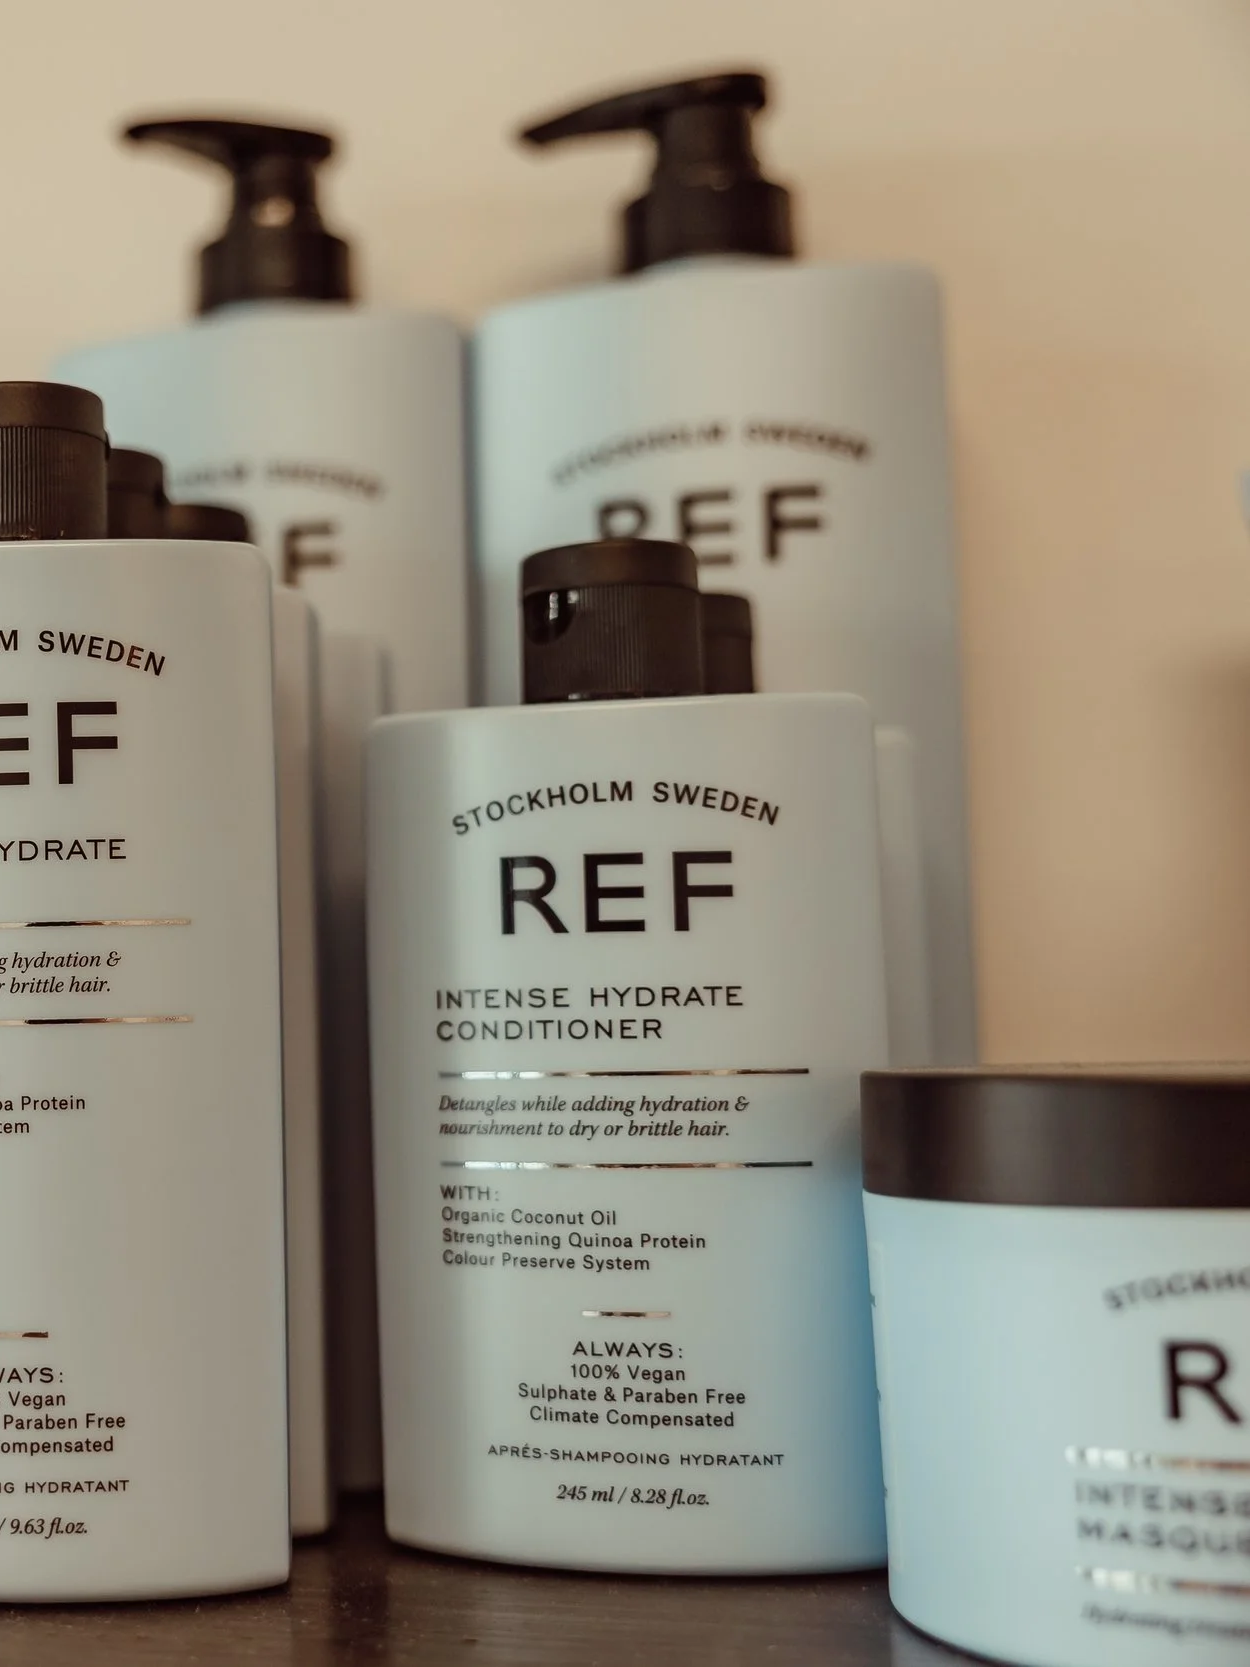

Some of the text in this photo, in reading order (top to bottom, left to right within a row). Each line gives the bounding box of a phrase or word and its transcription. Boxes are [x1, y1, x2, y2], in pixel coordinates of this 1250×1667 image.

[37, 630, 166, 677] SWEDEN
[452, 780, 780, 836] STOCKHOLM SWEDEN
[500, 850, 734, 935] REF
[11, 950, 102, 974] hydration
[105, 950, 122, 968] &
[9, 975, 65, 995] brittle
[68, 975, 111, 993] hair.
[436, 985, 744, 1010] INTENSE HYDRATE
[436, 1018, 663, 1042] CONDITIONER
[21, 1094, 86, 1111] Protein
[438, 1094, 751, 1118] Detangles while adding hydration &
[438, 1118, 730, 1141] nourishment to dry or brittle hair.
[439, 1184, 500, 1202] WITH:
[441, 1205, 617, 1226] Organic Coconut Oil
[442, 1227, 706, 1251] Strengthening Quinoa Protein
[442, 1248, 650, 1273] Colour Preserve System
[572, 1340, 683, 1359] ALWAYS:
[570, 1363, 686, 1385] 100% Vegan
[7, 1390, 66, 1411] Vegan
[518, 1382, 746, 1405] Sulphate & Paraben Free
[3, 1413, 78, 1431] Paraben
[85, 1412, 126, 1429] Free
[529, 1405, 735, 1430] Climate Compensated
[679, 1453, 785, 1467] HYDRATANT
[24, 1479, 130, 1494] HYDRATANT
[555, 1483, 710, 1510] 245 ml / 8.28 fl.oz.
[9, 1518, 46, 1535] 9.63
[41, 1516, 88, 1540] fl.oz.
